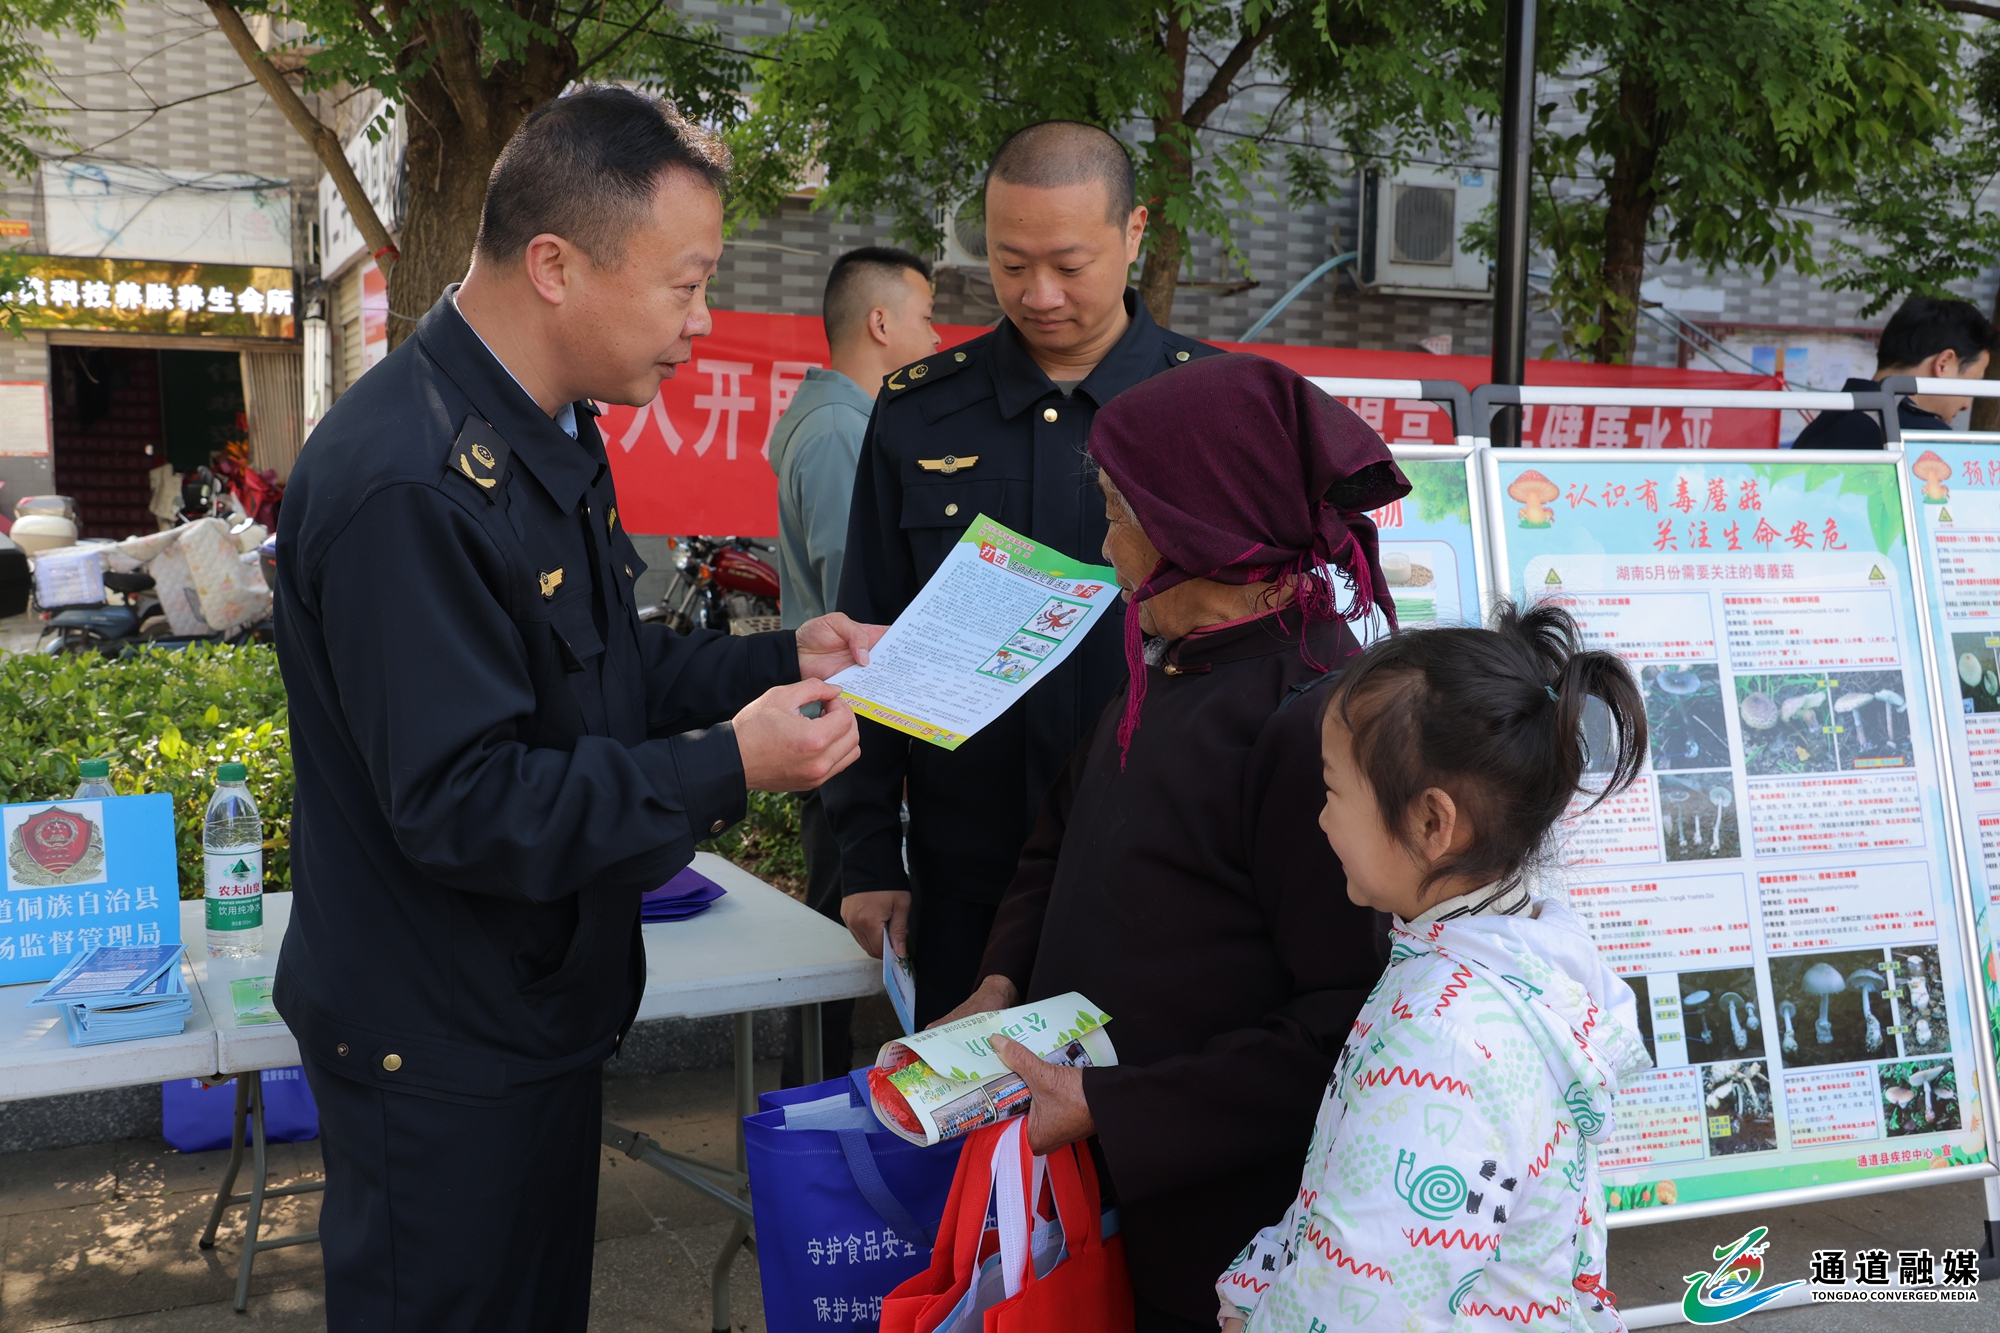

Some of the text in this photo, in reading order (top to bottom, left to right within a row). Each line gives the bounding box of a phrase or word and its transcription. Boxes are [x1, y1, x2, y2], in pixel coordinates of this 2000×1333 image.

[1, 277, 294, 316] 科技养肤养生会所
[1565, 477, 1763, 513] 认识有毒蘑菇
[1652, 517, 1848, 553] 关注生命安危
[1616, 563, 1795, 581] 湖南5月份需要关注的毒蘑菇
[219, 882, 260, 897] 农夫山泉
[218, 903, 261, 916] 饮用纯净水
[1857, 1144, 1952, 1169] 通道县疾控中心 宣
[812, 1295, 883, 1323] 保护知识
